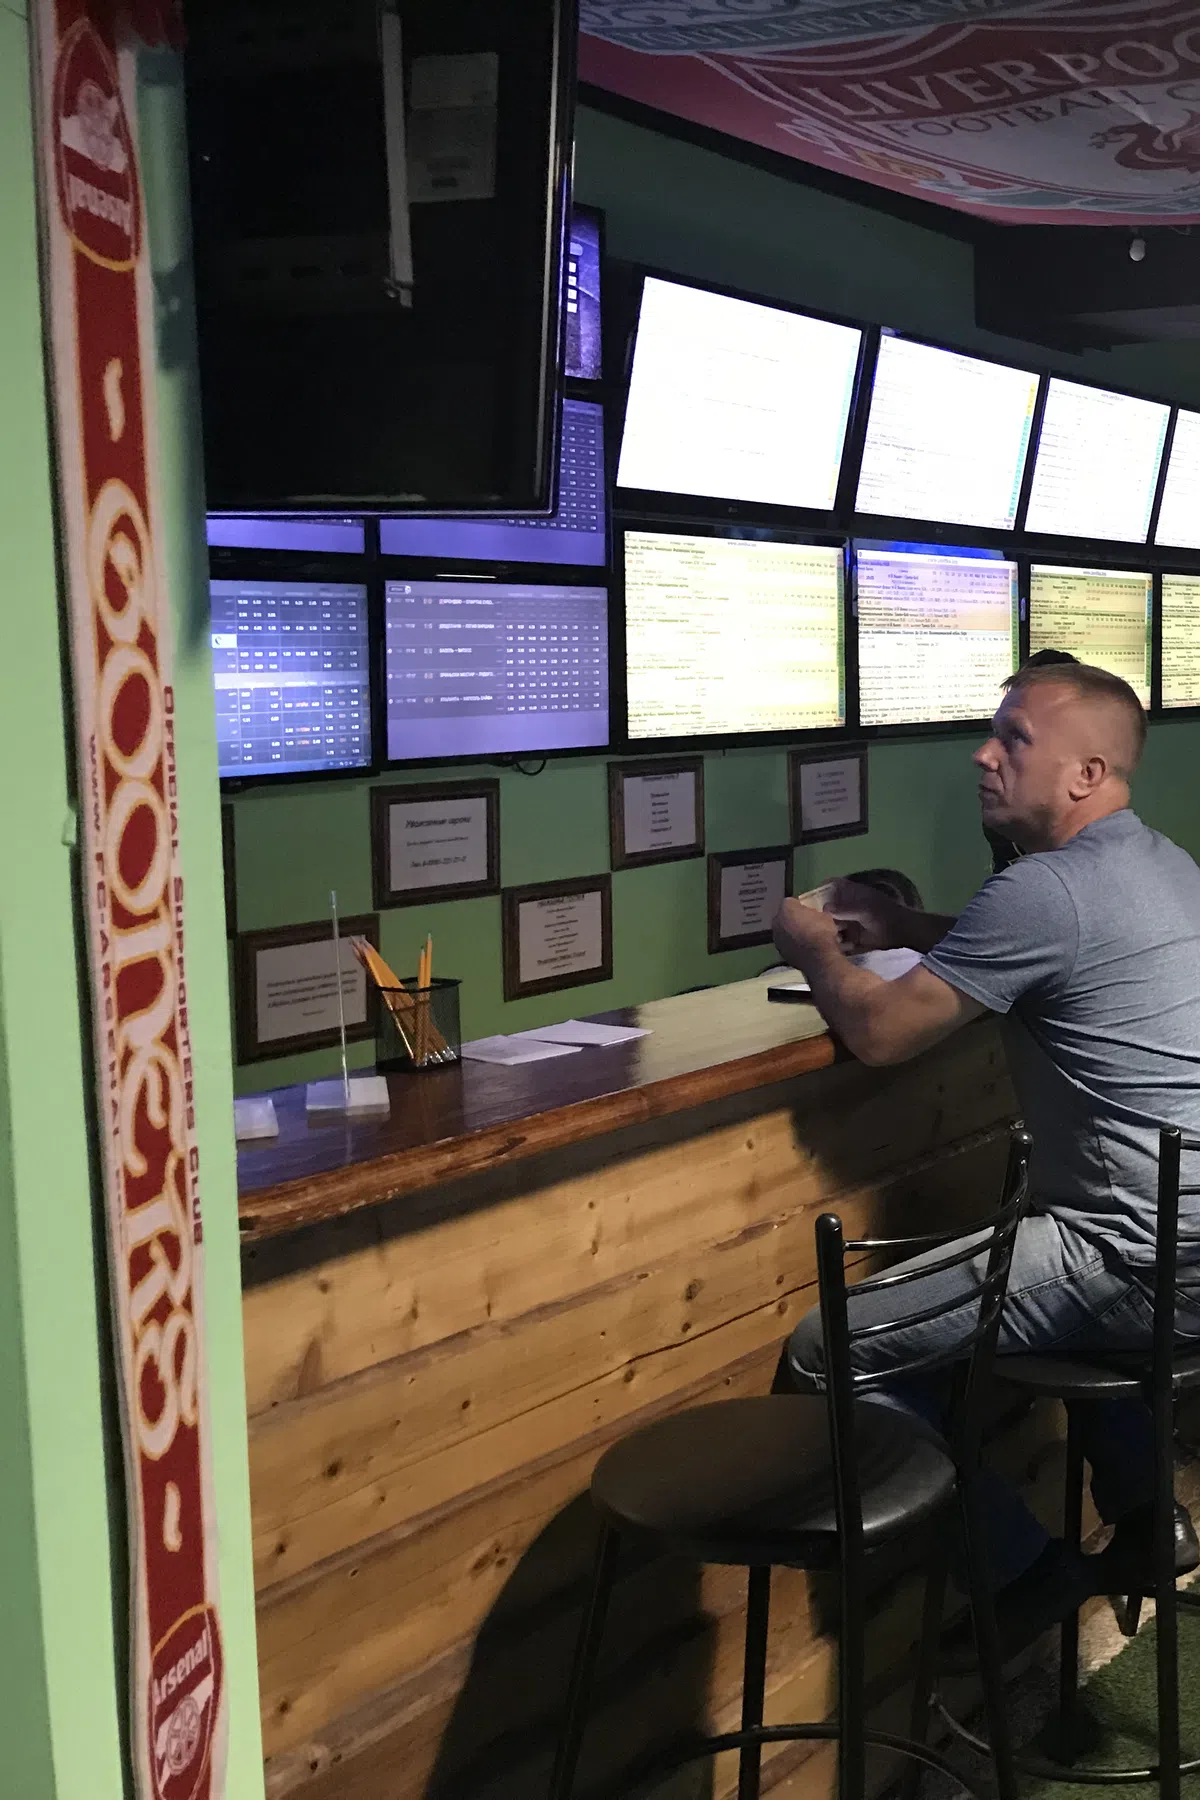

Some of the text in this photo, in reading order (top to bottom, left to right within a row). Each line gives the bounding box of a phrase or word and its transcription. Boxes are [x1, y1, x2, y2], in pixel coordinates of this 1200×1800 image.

[884, 88, 1156, 139] FOOTBALL
[68, 172, 131, 236] Arsenal
[152, 1626, 208, 1707] Arsenal
